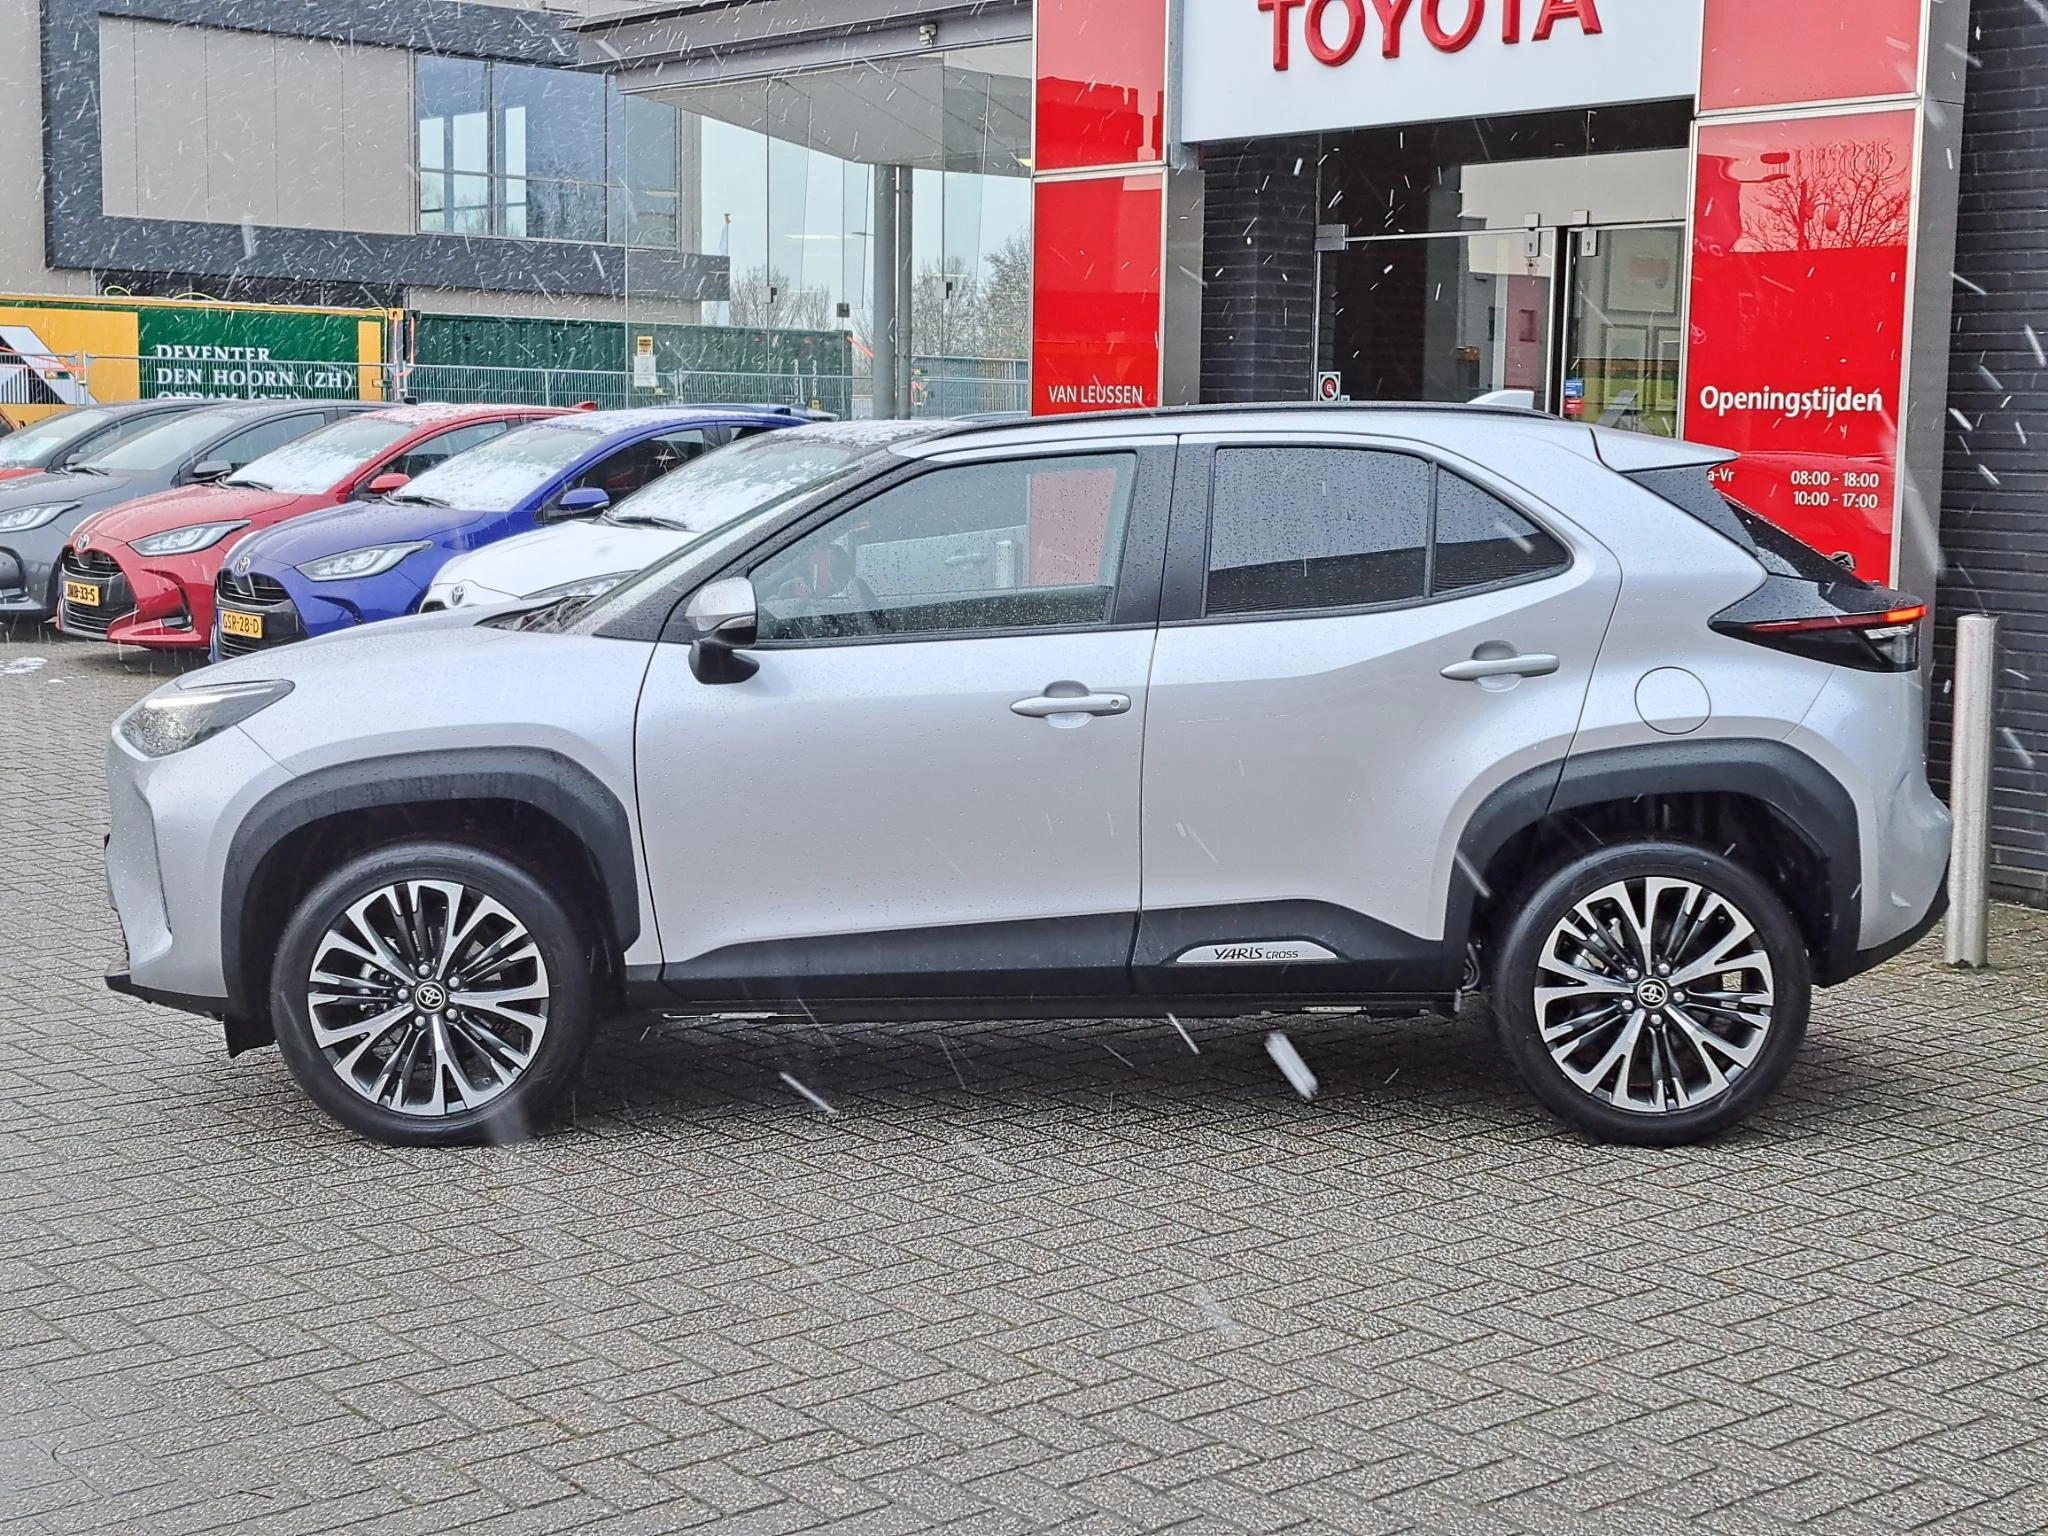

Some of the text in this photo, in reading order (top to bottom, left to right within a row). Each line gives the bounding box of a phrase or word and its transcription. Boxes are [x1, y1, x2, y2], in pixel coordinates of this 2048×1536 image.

[157, 344, 270, 361] DEVENTER
[157, 368, 353, 391] DEN HOORN (ZH)
[1048, 385, 1143, 404] VAN LEUSSEN
[1700, 386, 1882, 417] Openingstijden
[1707, 468, 1735, 483] a-Vr
[1790, 470, 1830, 486] 08:00
[1842, 472, 1880, 488] 18:00
[1793, 491, 1830, 506] 10:00
[1842, 493, 1878, 508] 17:00
[223, 613, 260, 634] GSR-28-D
[1214, 946, 1299, 960] YARIS CROSS
